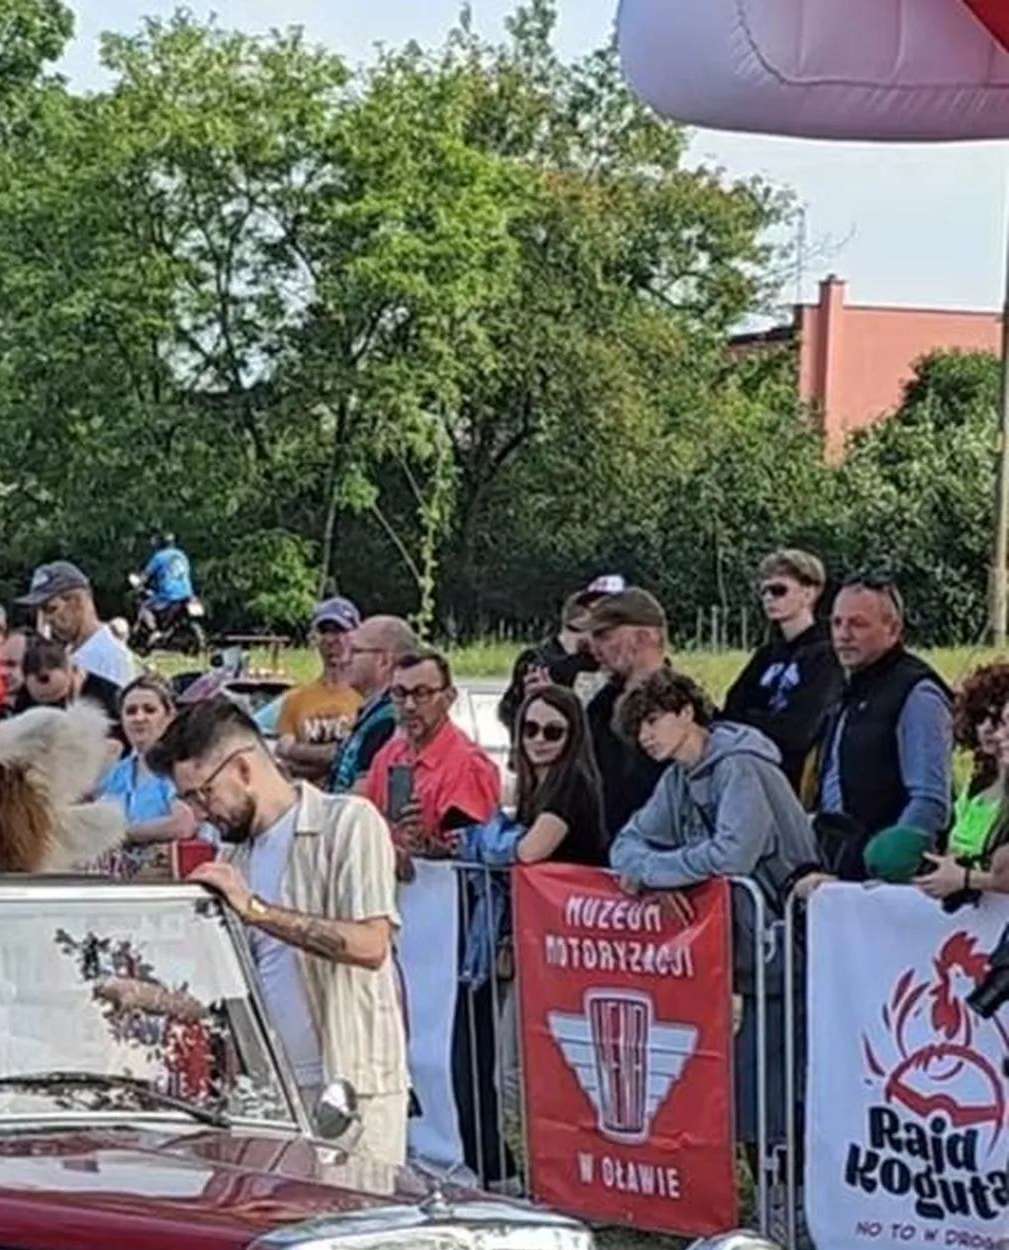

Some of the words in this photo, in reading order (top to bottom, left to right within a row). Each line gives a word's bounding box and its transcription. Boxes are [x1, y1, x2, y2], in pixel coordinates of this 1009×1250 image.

[565, 895, 662, 932] MUZEUM
[545, 934, 694, 978] MOTORYZACJI
[868, 1106, 979, 1175] Rajd
[578, 1151, 594, 1184] W
[601, 1156, 680, 1199] OŁAWIE
[856, 1221, 883, 1237] NO
[891, 1223, 917, 1241] TO
